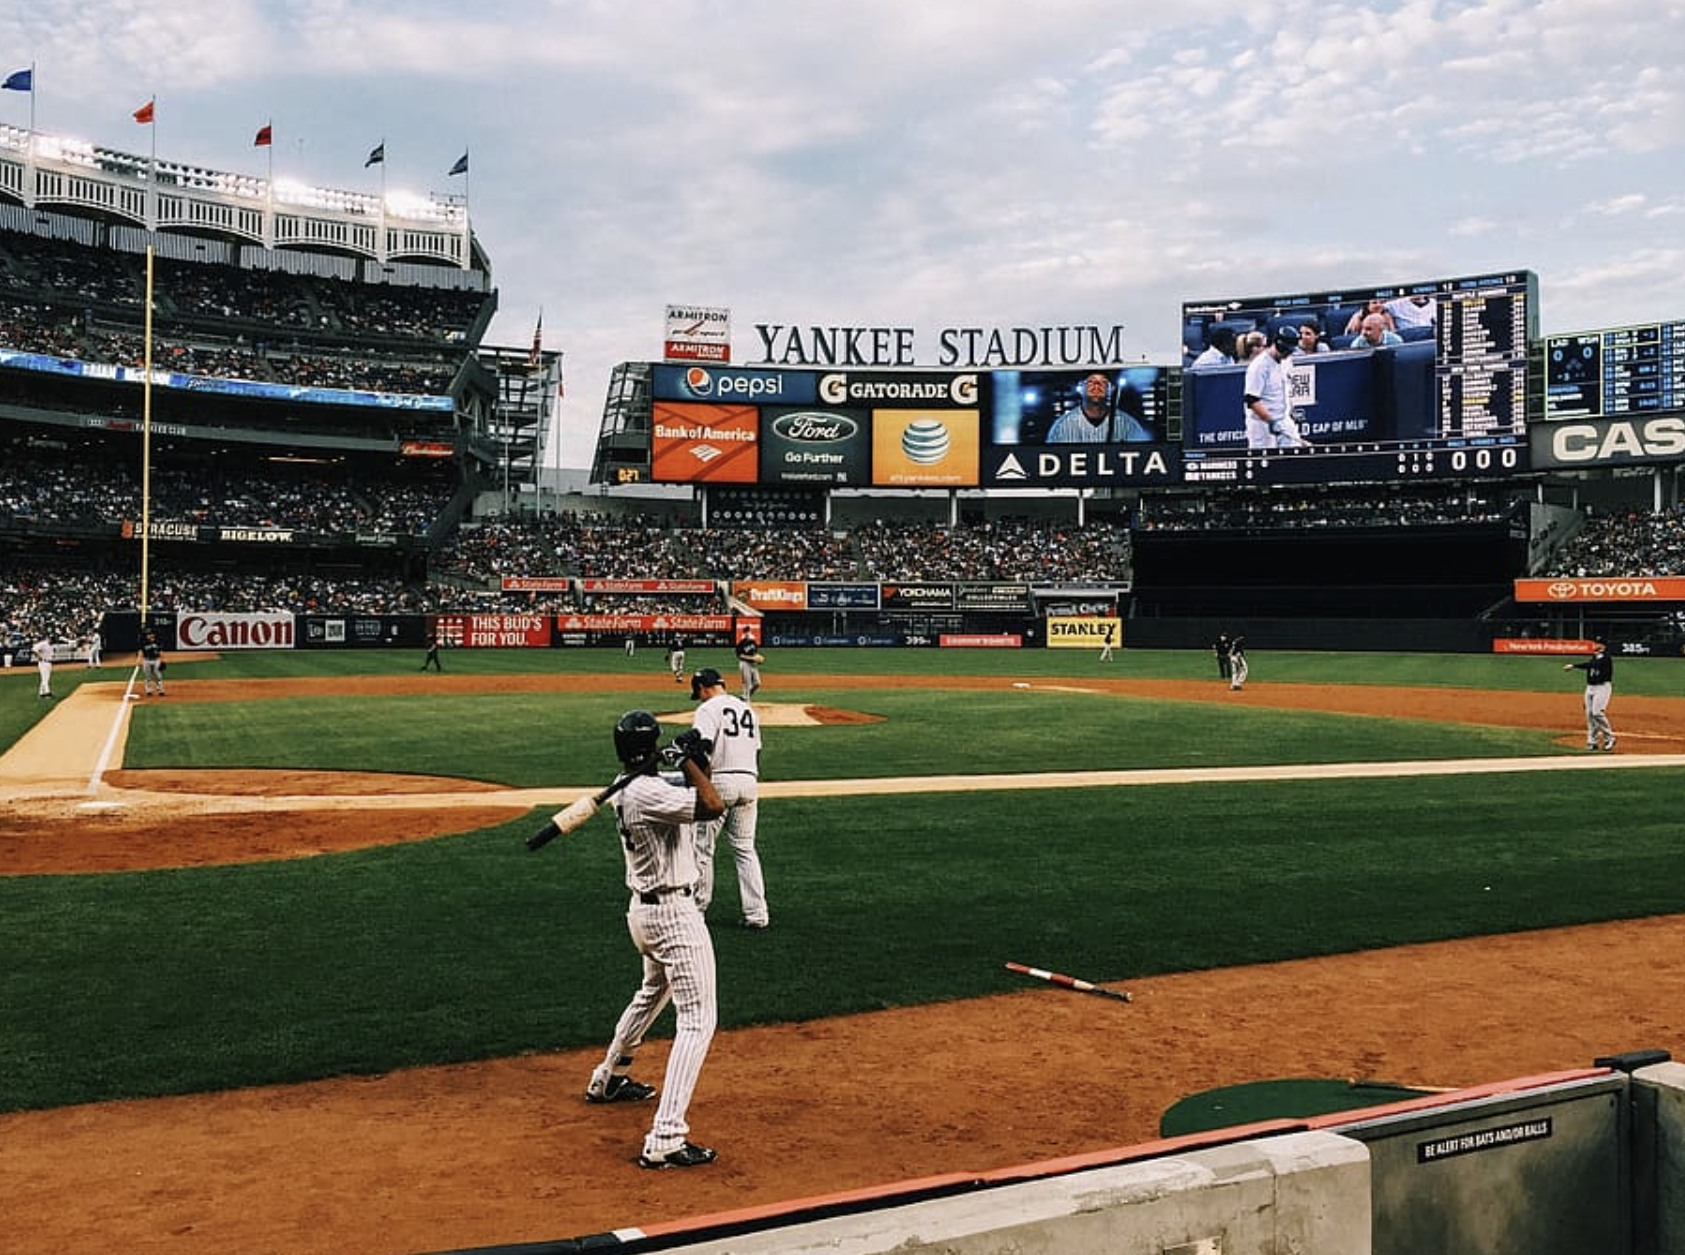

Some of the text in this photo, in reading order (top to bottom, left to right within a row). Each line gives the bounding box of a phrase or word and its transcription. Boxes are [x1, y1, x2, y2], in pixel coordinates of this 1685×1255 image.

[668, 310, 728, 322] ARMITRON
[755, 324, 1124, 366] YANKEE STADIUM
[717, 375, 782, 398] pepsi
[850, 383, 948, 398] GATORADE
[655, 424, 756, 441] Bank of America
[788, 415, 840, 438] Ford
[785, 451, 844, 463] Go Further
[1038, 452, 1167, 477] DELTA
[1452, 448, 1517, 470] 0 0 0
[898, 588, 951, 598] YOKOHAMA
[1579, 583, 1657, 596] TOYOTA
[179, 616, 293, 646] Canon
[471, 616, 542, 631] THIS BUD'S
[1051, 623, 1115, 635] STANLEY
[471, 632, 529, 646] FOR YOU.
[723, 707, 755, 738] 34
[1425, 1143, 1436, 1157] BE
[1436, 1139, 1459, 1154] ALERT
[1460, 1136, 1474, 1149] FOR
[1476, 1132, 1494, 1146] BATS
[1525, 1121, 1548, 1137] BALLS
